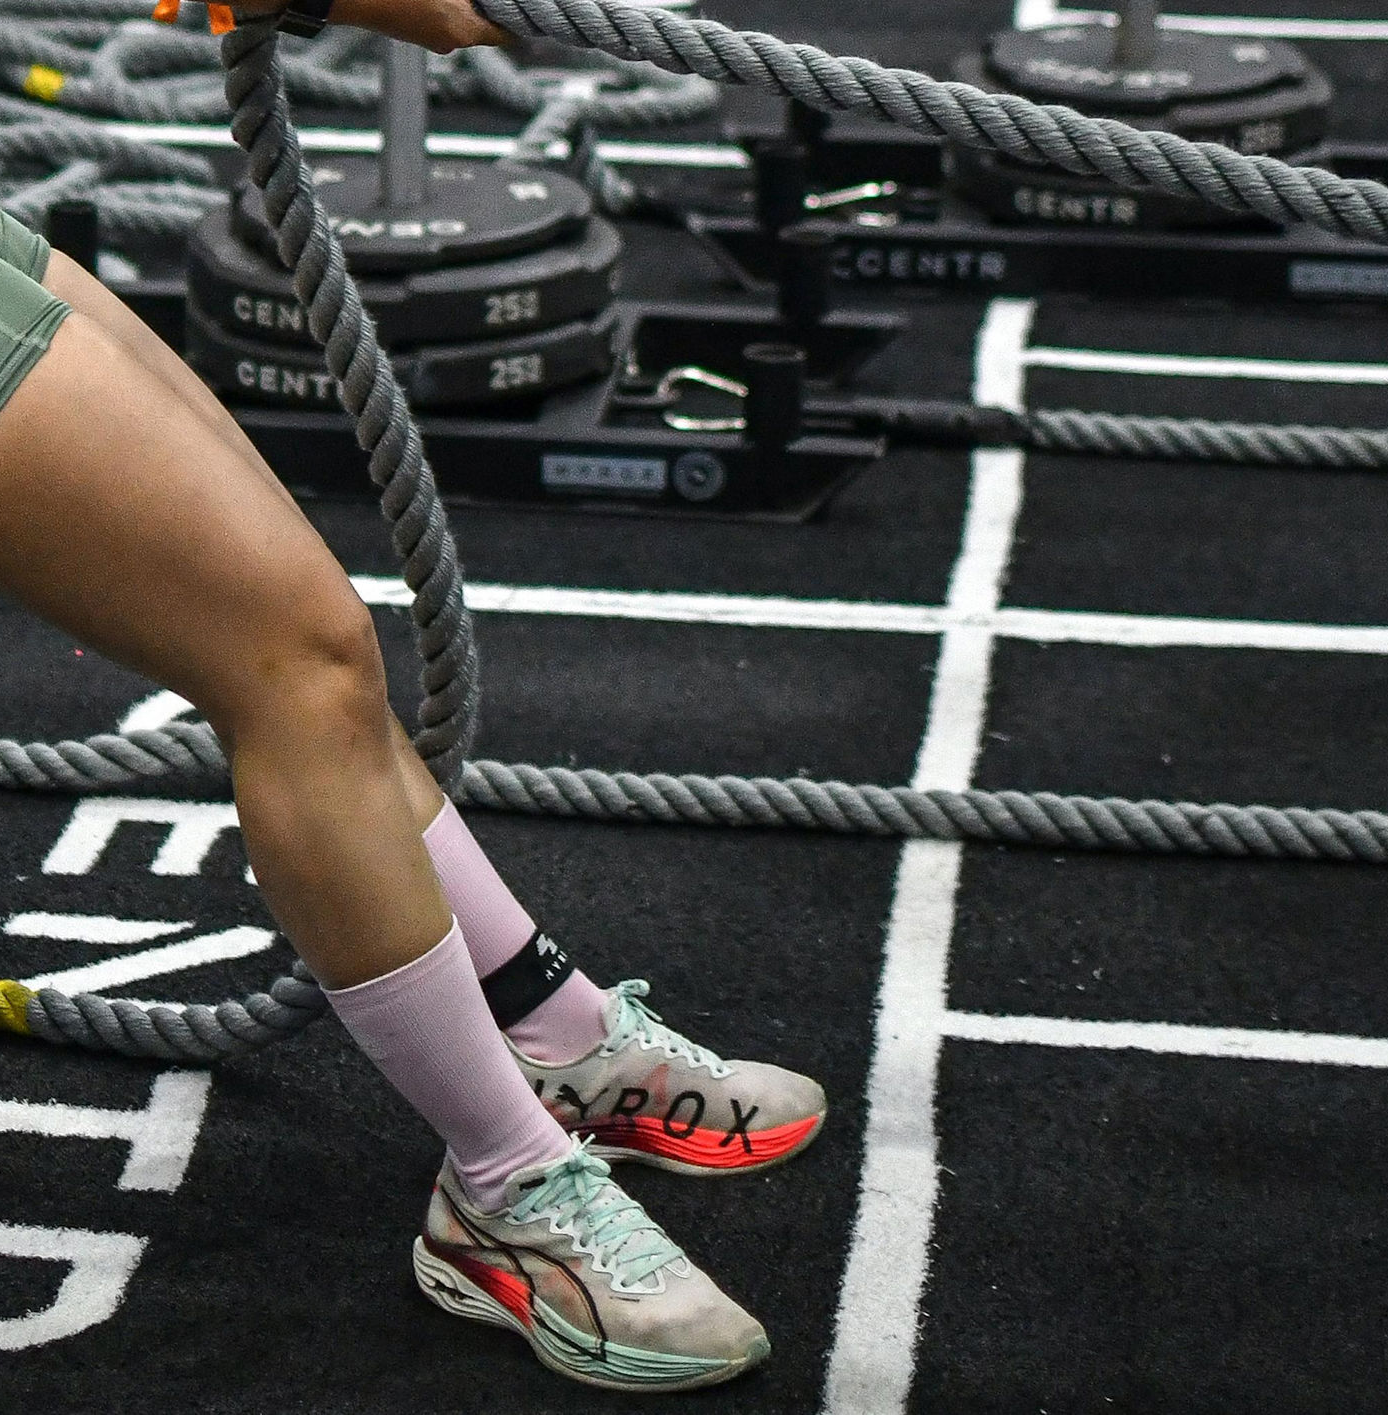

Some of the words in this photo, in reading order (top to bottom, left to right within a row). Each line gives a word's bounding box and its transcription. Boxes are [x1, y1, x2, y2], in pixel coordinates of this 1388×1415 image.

[1014, 188, 1139, 224] CENTR
[232, 293, 306, 332] CEN
[235, 360, 343, 403] CENT
